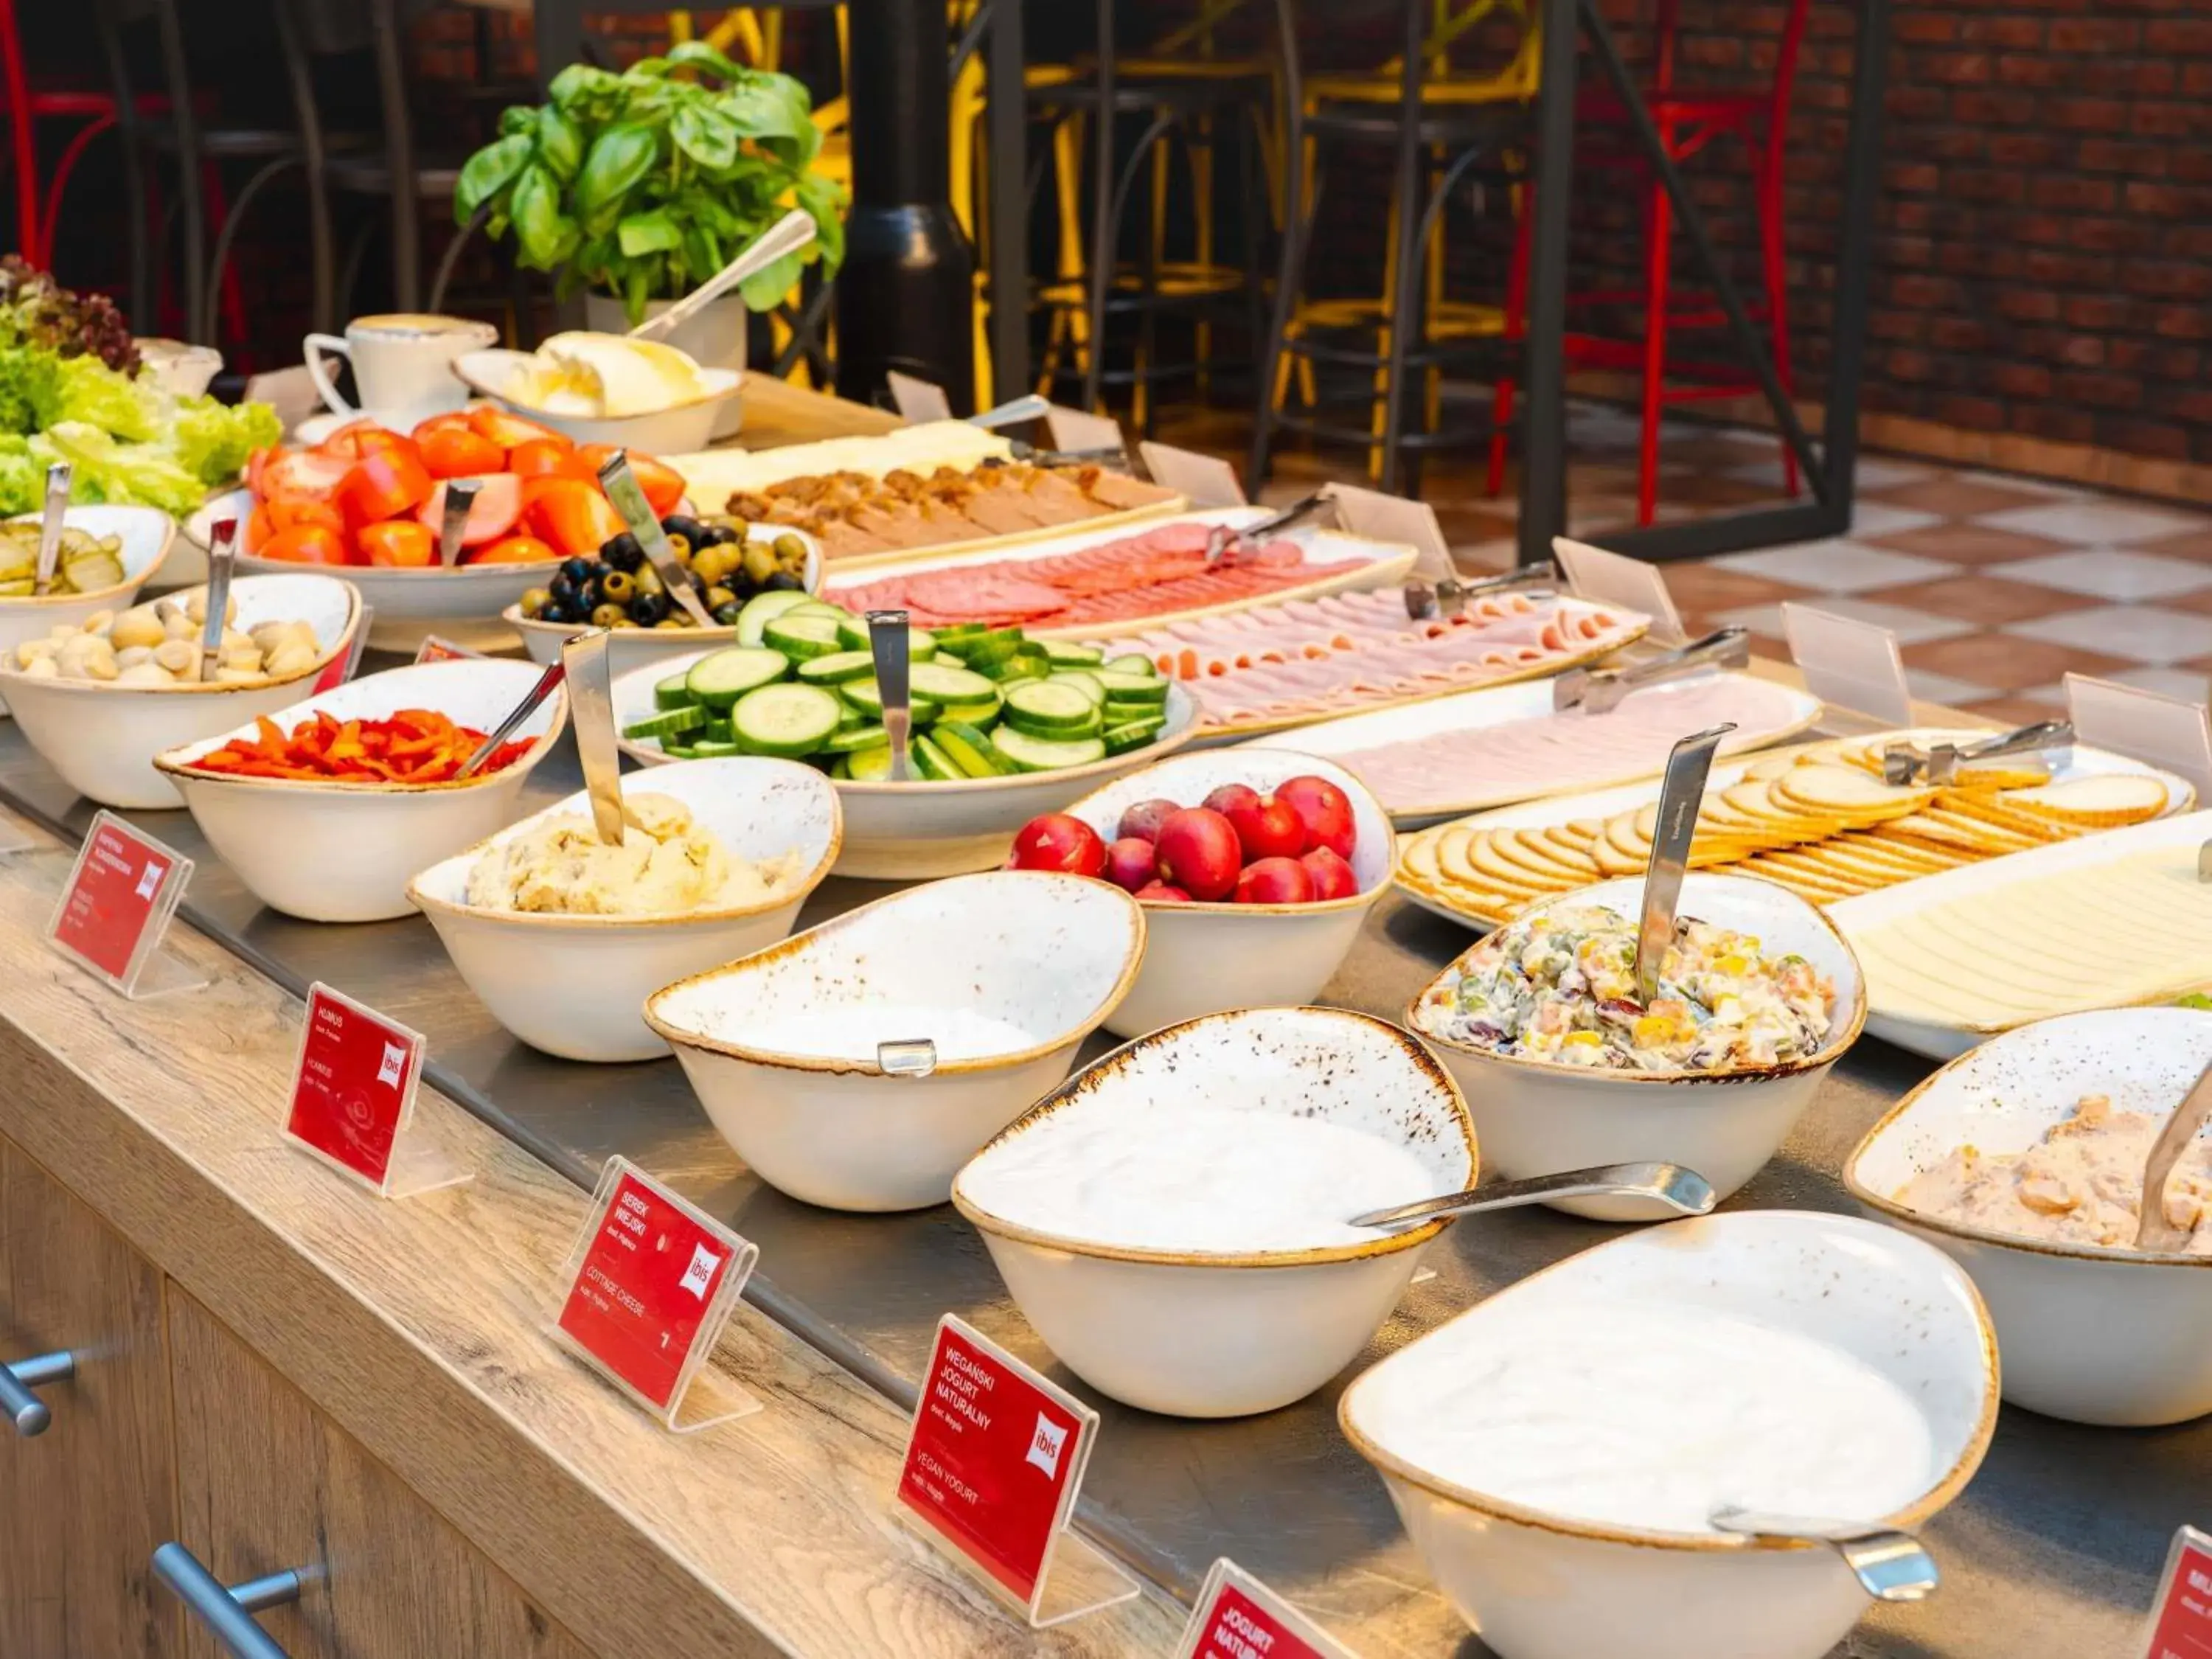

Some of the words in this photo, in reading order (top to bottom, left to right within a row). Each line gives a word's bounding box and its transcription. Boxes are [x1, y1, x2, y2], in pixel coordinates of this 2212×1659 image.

[614, 1204, 646, 1237] WIEJSKI
[621, 1191, 649, 1218] SEREK
[690, 1257, 709, 1282] ibis
[586, 1265, 619, 1296] COTTAGE
[616, 1288, 644, 1318] CHEESE
[940, 1364, 979, 1400] JOGURT
[946, 1344, 995, 1393] WEGAŃSKI
[936, 1380, 991, 1432] NATURALNY
[1036, 1428, 1057, 1458] ibis
[917, 1448, 945, 1481] VEGAN
[945, 1470, 979, 1506] YOGURT
[1222, 1606, 1276, 1654] JOGURT
